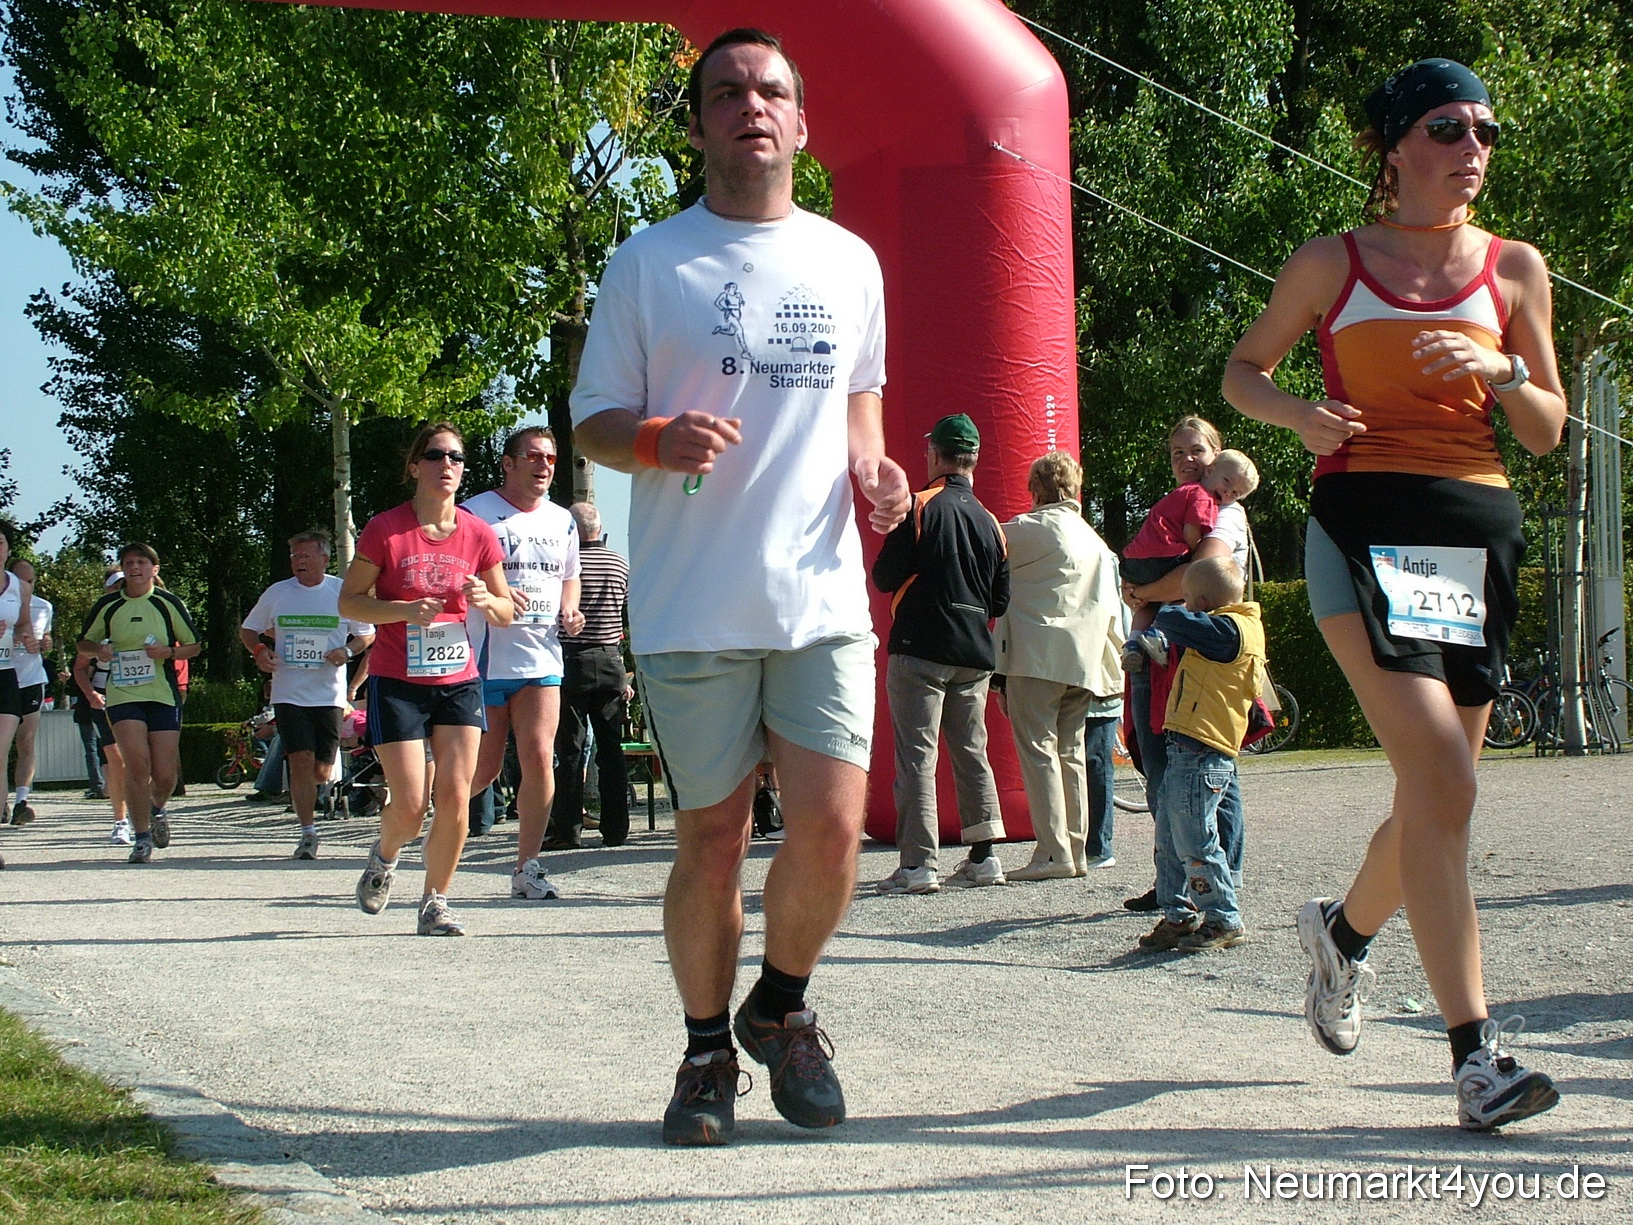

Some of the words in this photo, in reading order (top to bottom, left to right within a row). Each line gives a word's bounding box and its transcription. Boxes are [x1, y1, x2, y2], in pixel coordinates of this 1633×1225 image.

[773, 322, 836, 334] 16.09.2007
[721, 356, 745, 376] 8.
[750, 361, 835, 375] Neumarkter
[769, 375, 835, 389] Stadtlauf
[1045, 394, 1055, 424] 1929
[528, 536, 560, 548] PLAST
[422, 553, 436, 562] BY
[503, 561, 537, 571] RUNNING
[540, 562, 560, 573] TEAM
[1402, 555, 1438, 578] Antje
[522, 584, 542, 594] Tobias
[524, 600, 552, 613] 3066
[1413, 589, 1479, 619] 2712
[425, 628, 445, 640] Tanja
[295, 637, 314, 646] Ludwig
[295, 649, 323, 660] 3501
[426, 645, 466, 661] 2822
[123, 664, 152, 677] 3327
